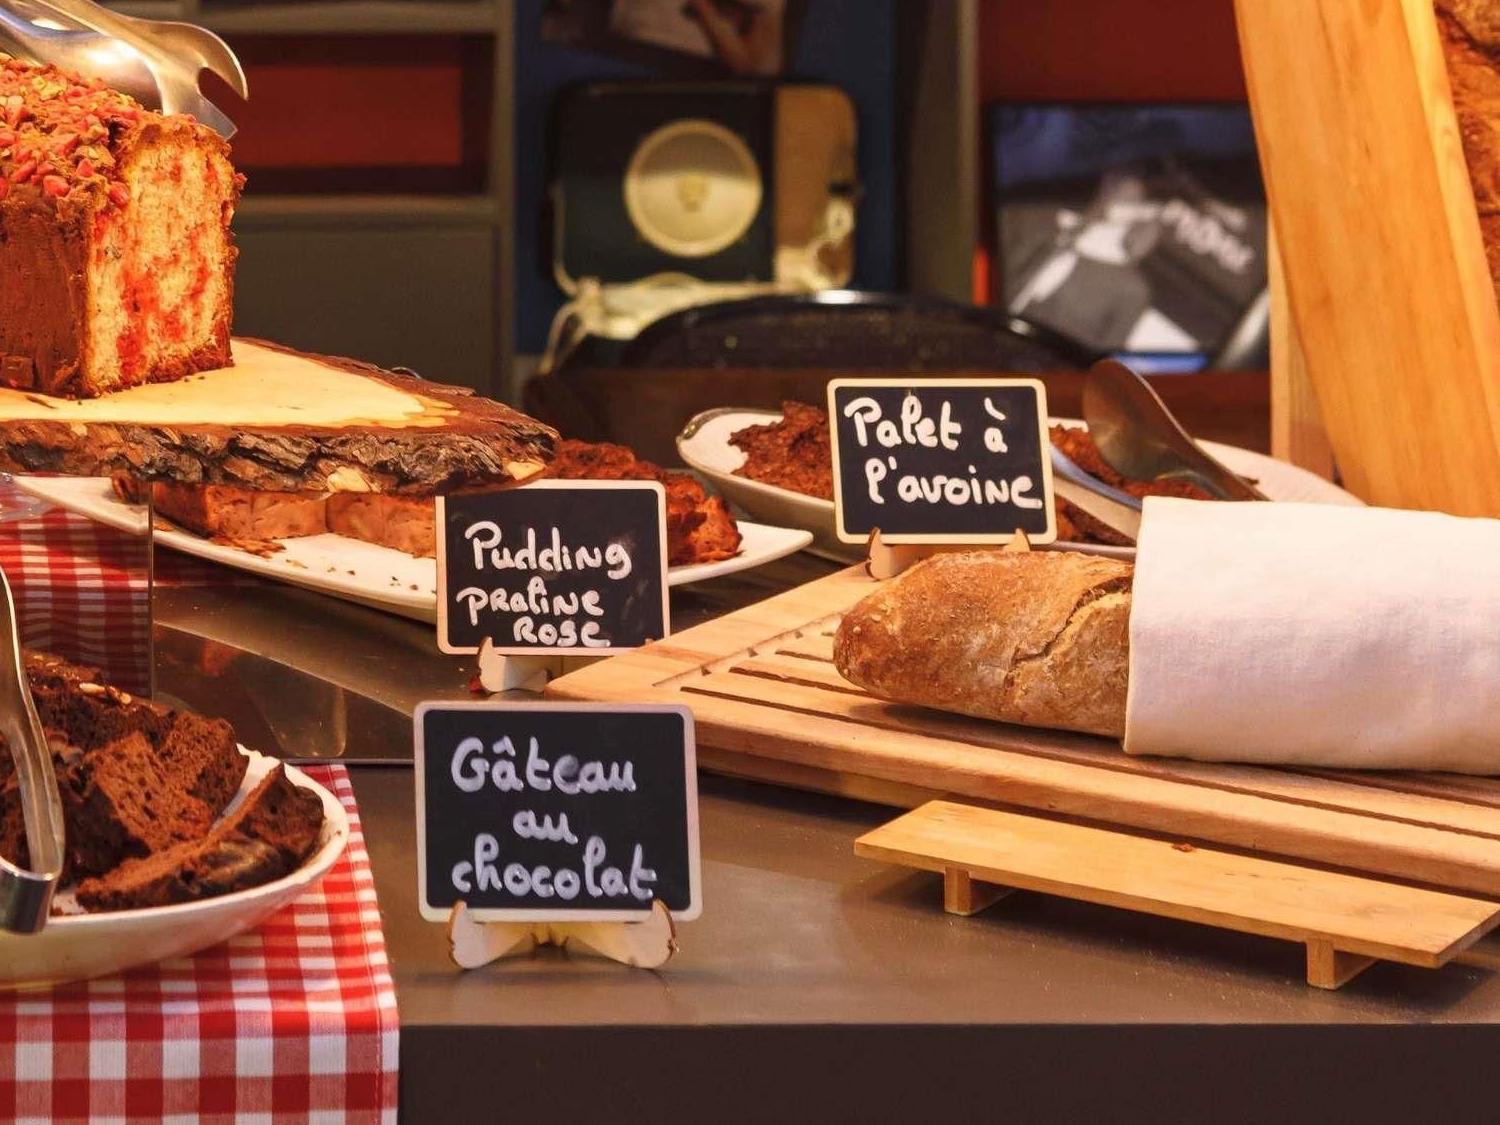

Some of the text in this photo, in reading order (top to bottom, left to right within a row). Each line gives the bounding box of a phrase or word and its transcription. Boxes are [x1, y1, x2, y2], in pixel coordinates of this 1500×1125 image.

[844, 395, 1008, 454] Palet à
[865, 456, 1043, 509] l'avoine
[464, 521, 632, 580] Pudding
[451, 735, 637, 795] Gâteau
[512, 810, 579, 845] au
[451, 833, 658, 901] chocolat
